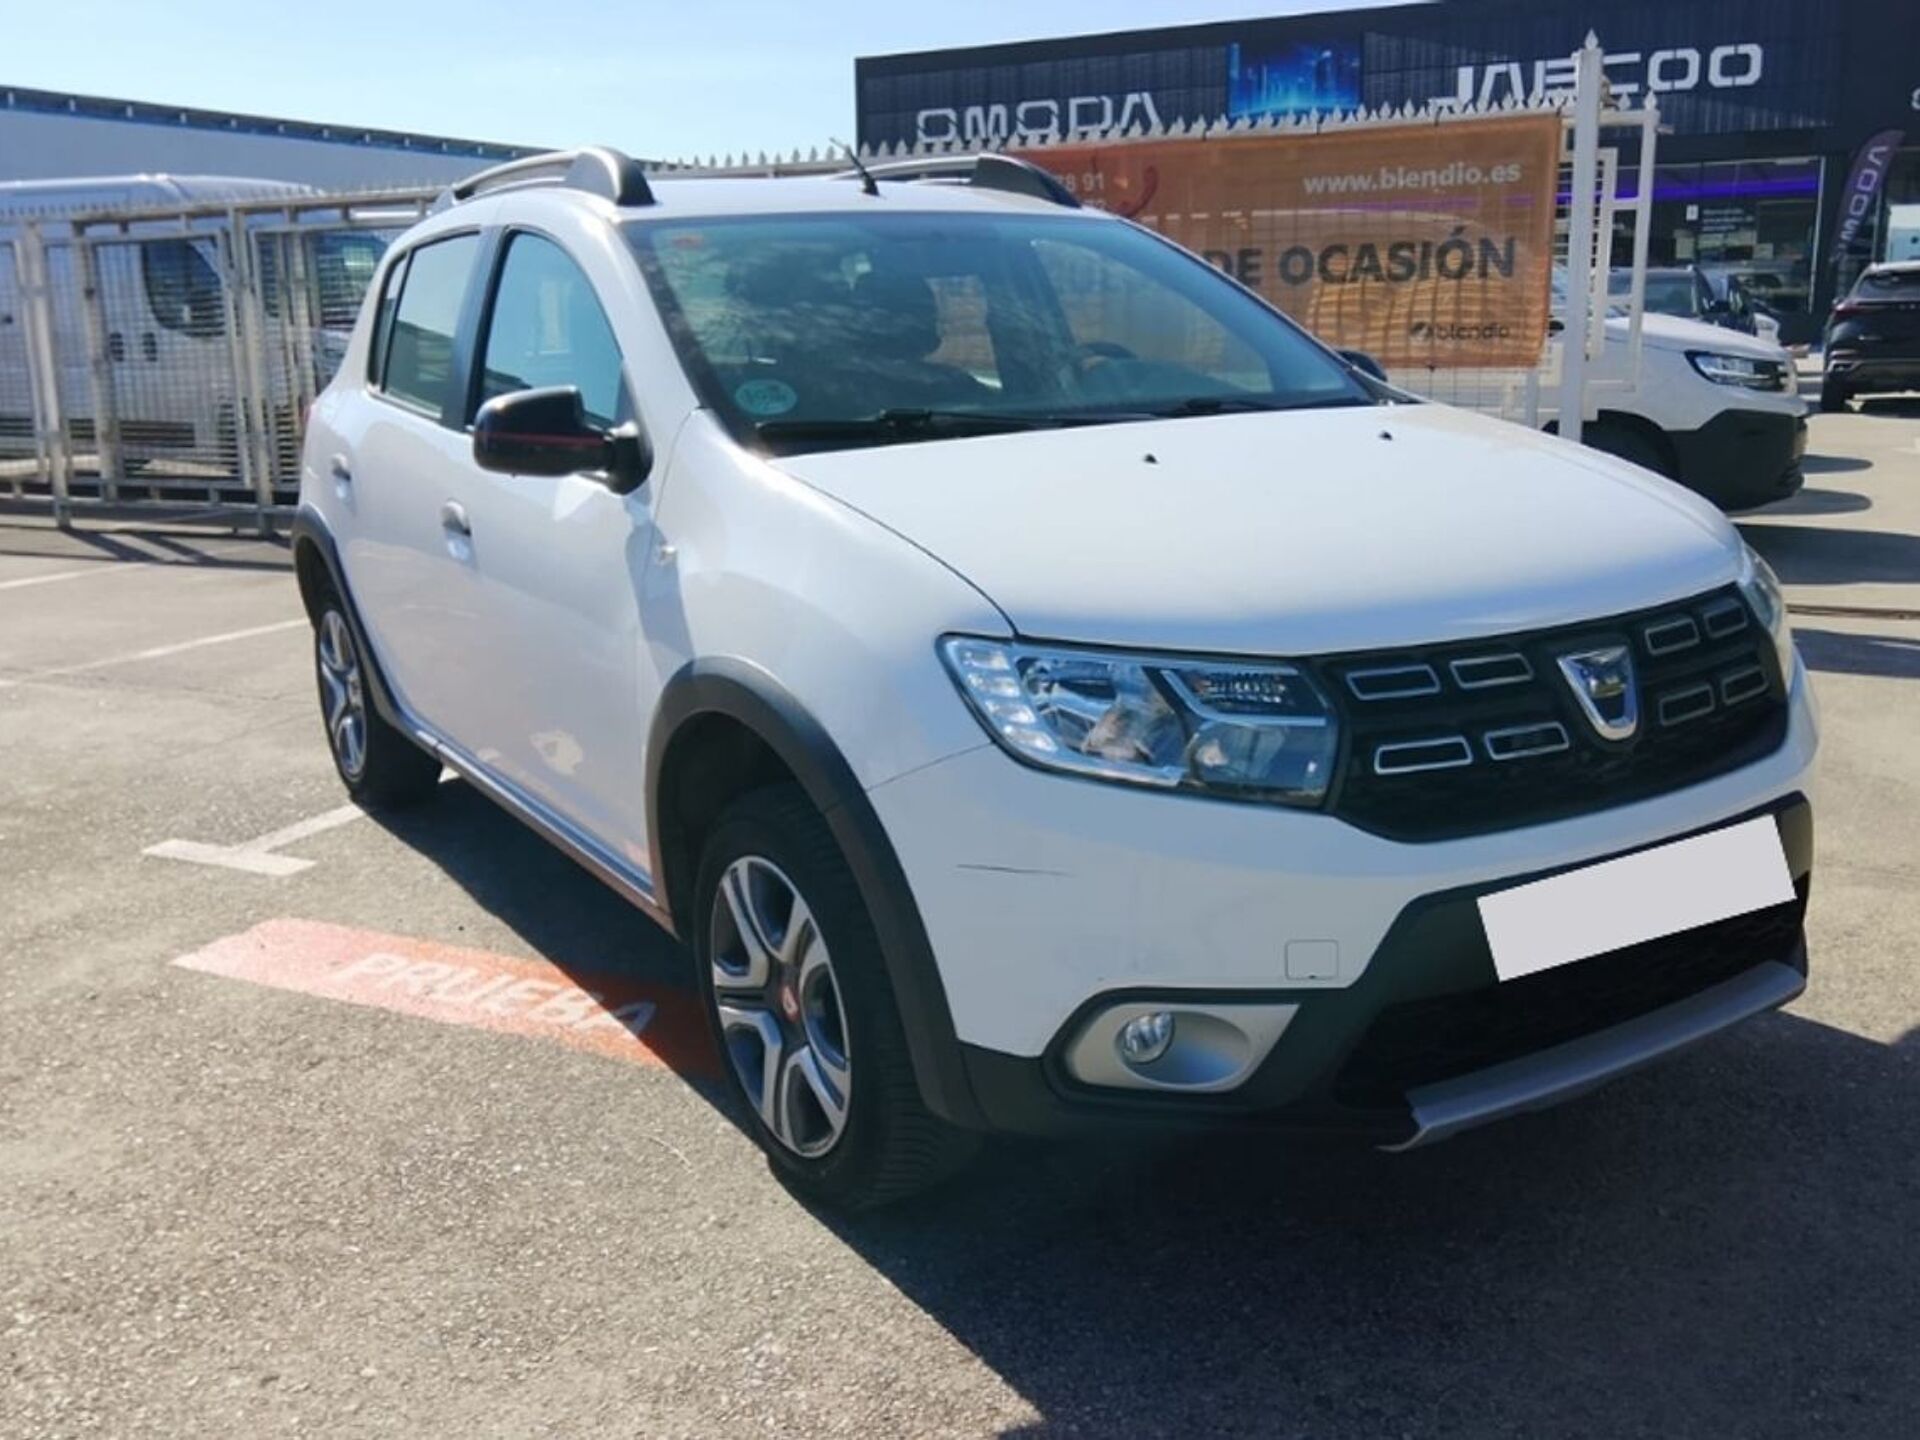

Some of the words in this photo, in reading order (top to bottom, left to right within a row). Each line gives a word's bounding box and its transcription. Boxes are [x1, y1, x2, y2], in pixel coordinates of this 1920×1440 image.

[1428, 43, 1763, 104] JAECOO
[917, 92, 1165, 144] OMODA
[1303, 161, 1521, 195] www.blendio.es
[1202, 247, 1262, 287] DE
[1278, 225, 1516, 287] OCASIÓN
[332, 953, 656, 1034] PRUEBA
